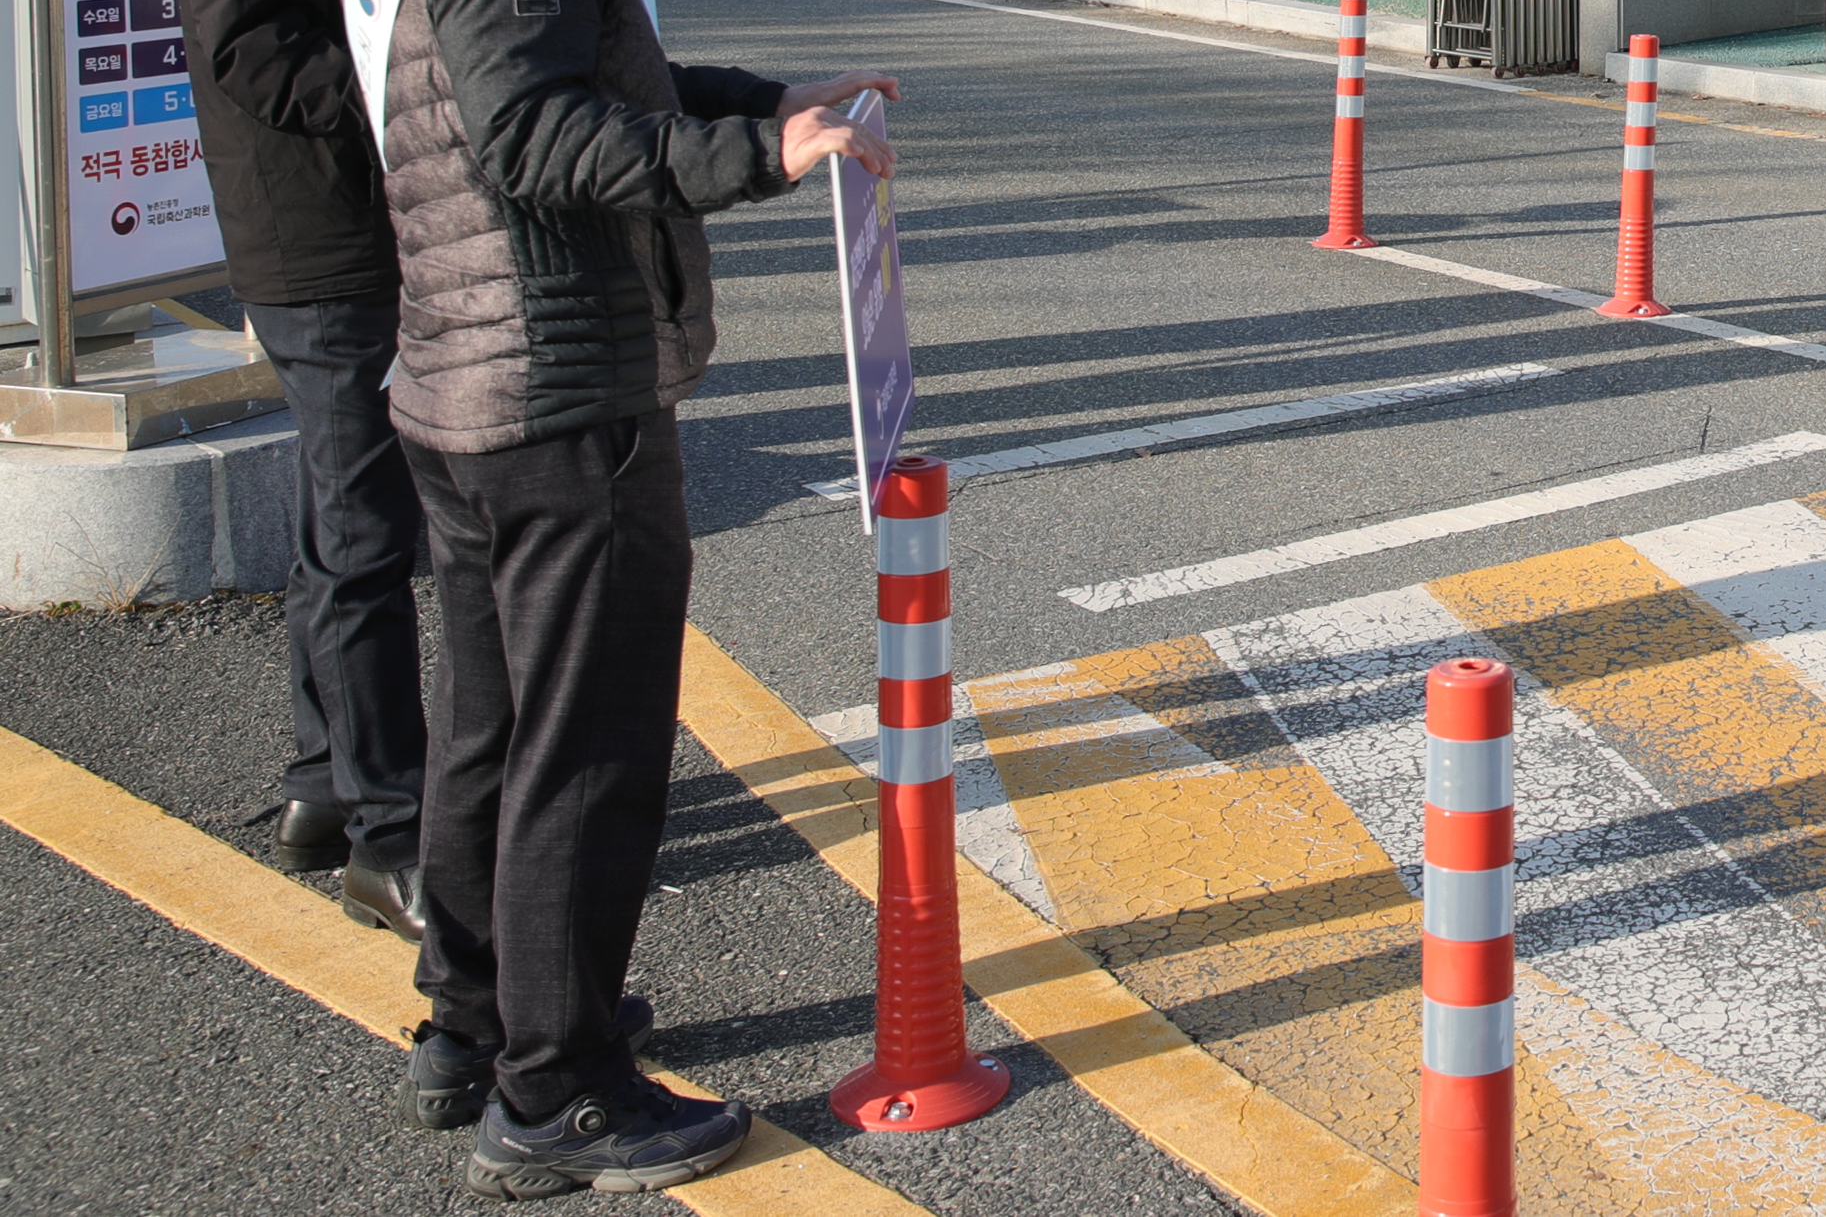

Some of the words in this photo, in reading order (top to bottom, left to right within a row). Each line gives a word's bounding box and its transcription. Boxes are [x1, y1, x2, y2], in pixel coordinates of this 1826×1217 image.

[83, 7, 120, 25] 수요일
[85, 54, 121, 72] 목요일
[86, 102, 123, 120] 금요일
[81, 149, 122, 183] 적극
[147, 204, 211, 226] 국립축산과학원
